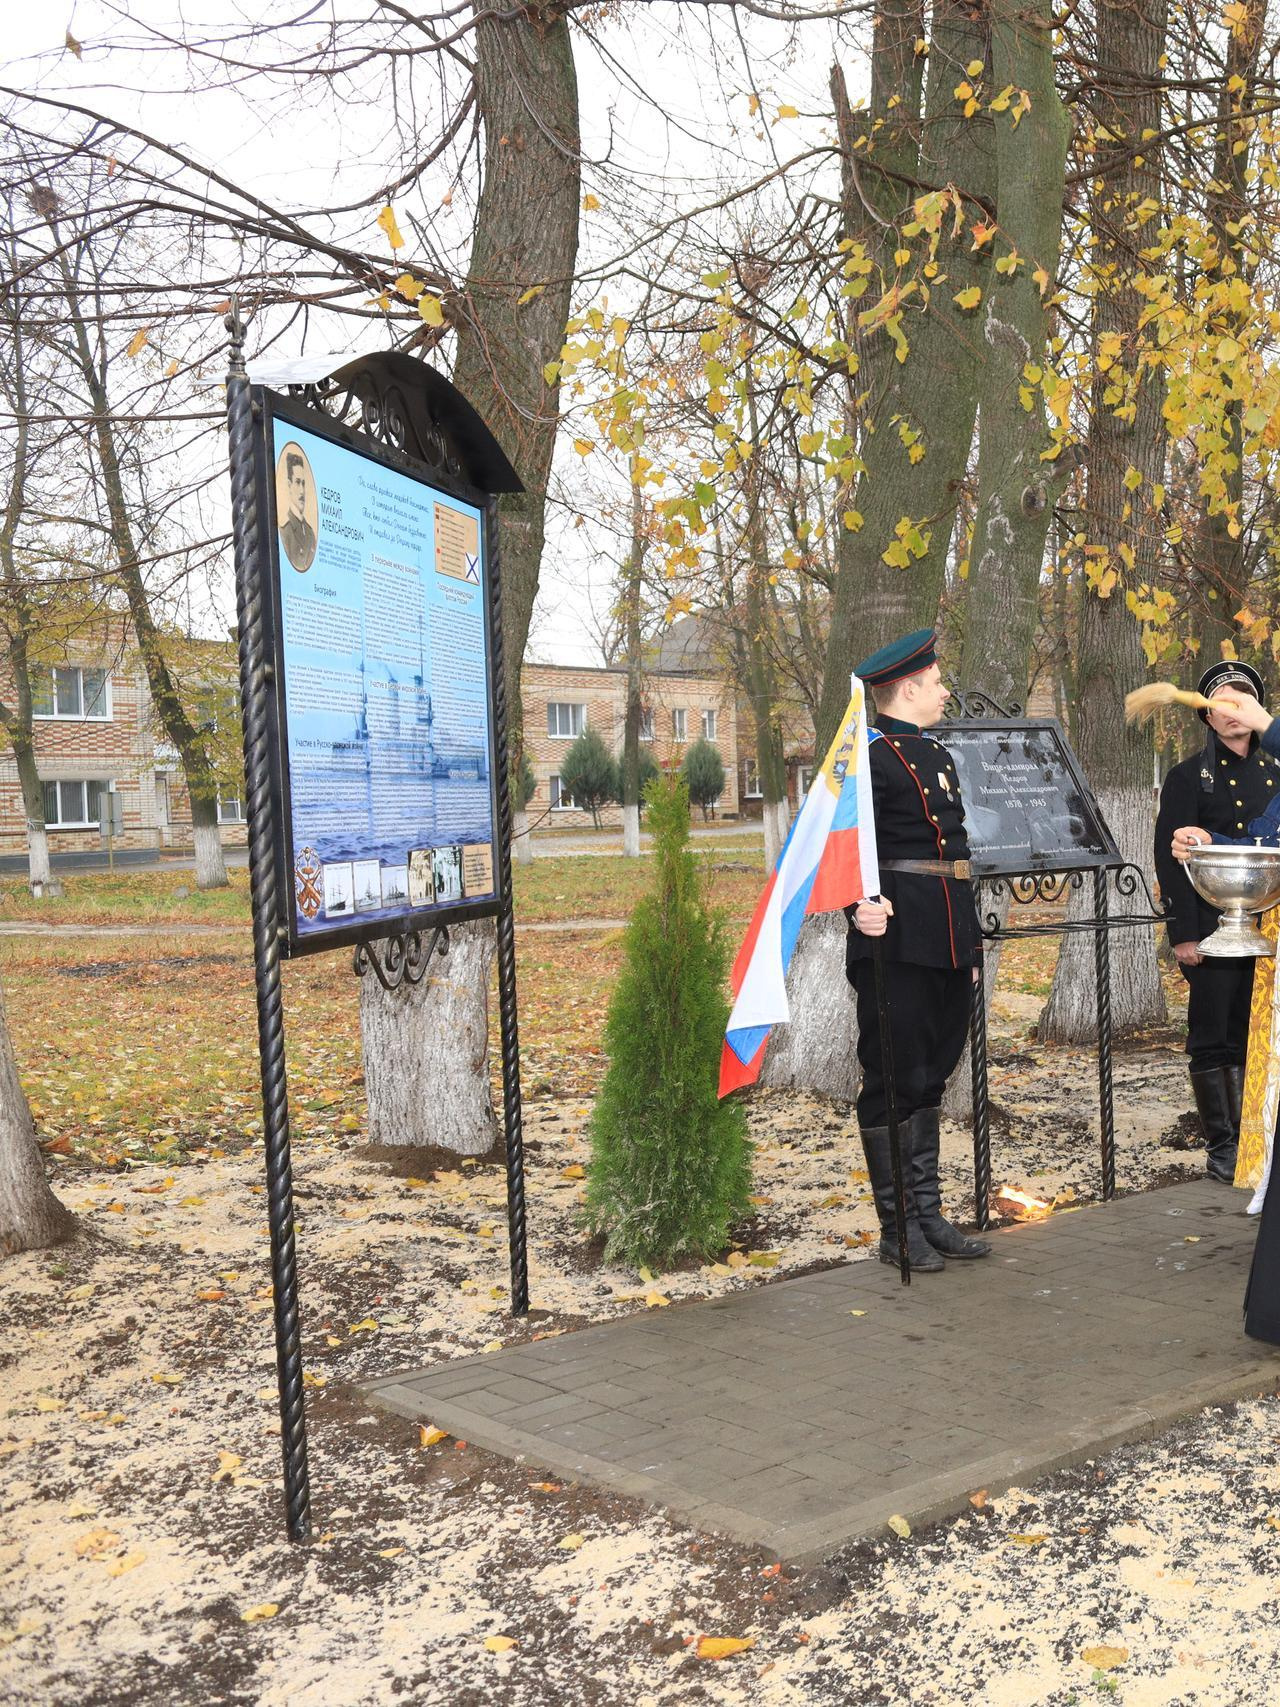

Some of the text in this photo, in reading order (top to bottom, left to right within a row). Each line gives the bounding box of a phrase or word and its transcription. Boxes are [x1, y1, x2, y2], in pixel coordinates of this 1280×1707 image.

[321, 486, 341, 504] КЕДРОВ
[321, 502, 343, 520] МИХАИЛ
[322, 518, 365, 542] АЛЕКСАНДРОВИЧ
[314, 583, 337, 598] Биография
[980, 761, 1039, 773] Вице-адмирал
[1001, 773, 1028, 783] Кедров
[979, 784, 1060, 795] Михаил Александрович
[1004, 799, 1023, 809] 1878
[1029, 798, 1047, 808] 1945
